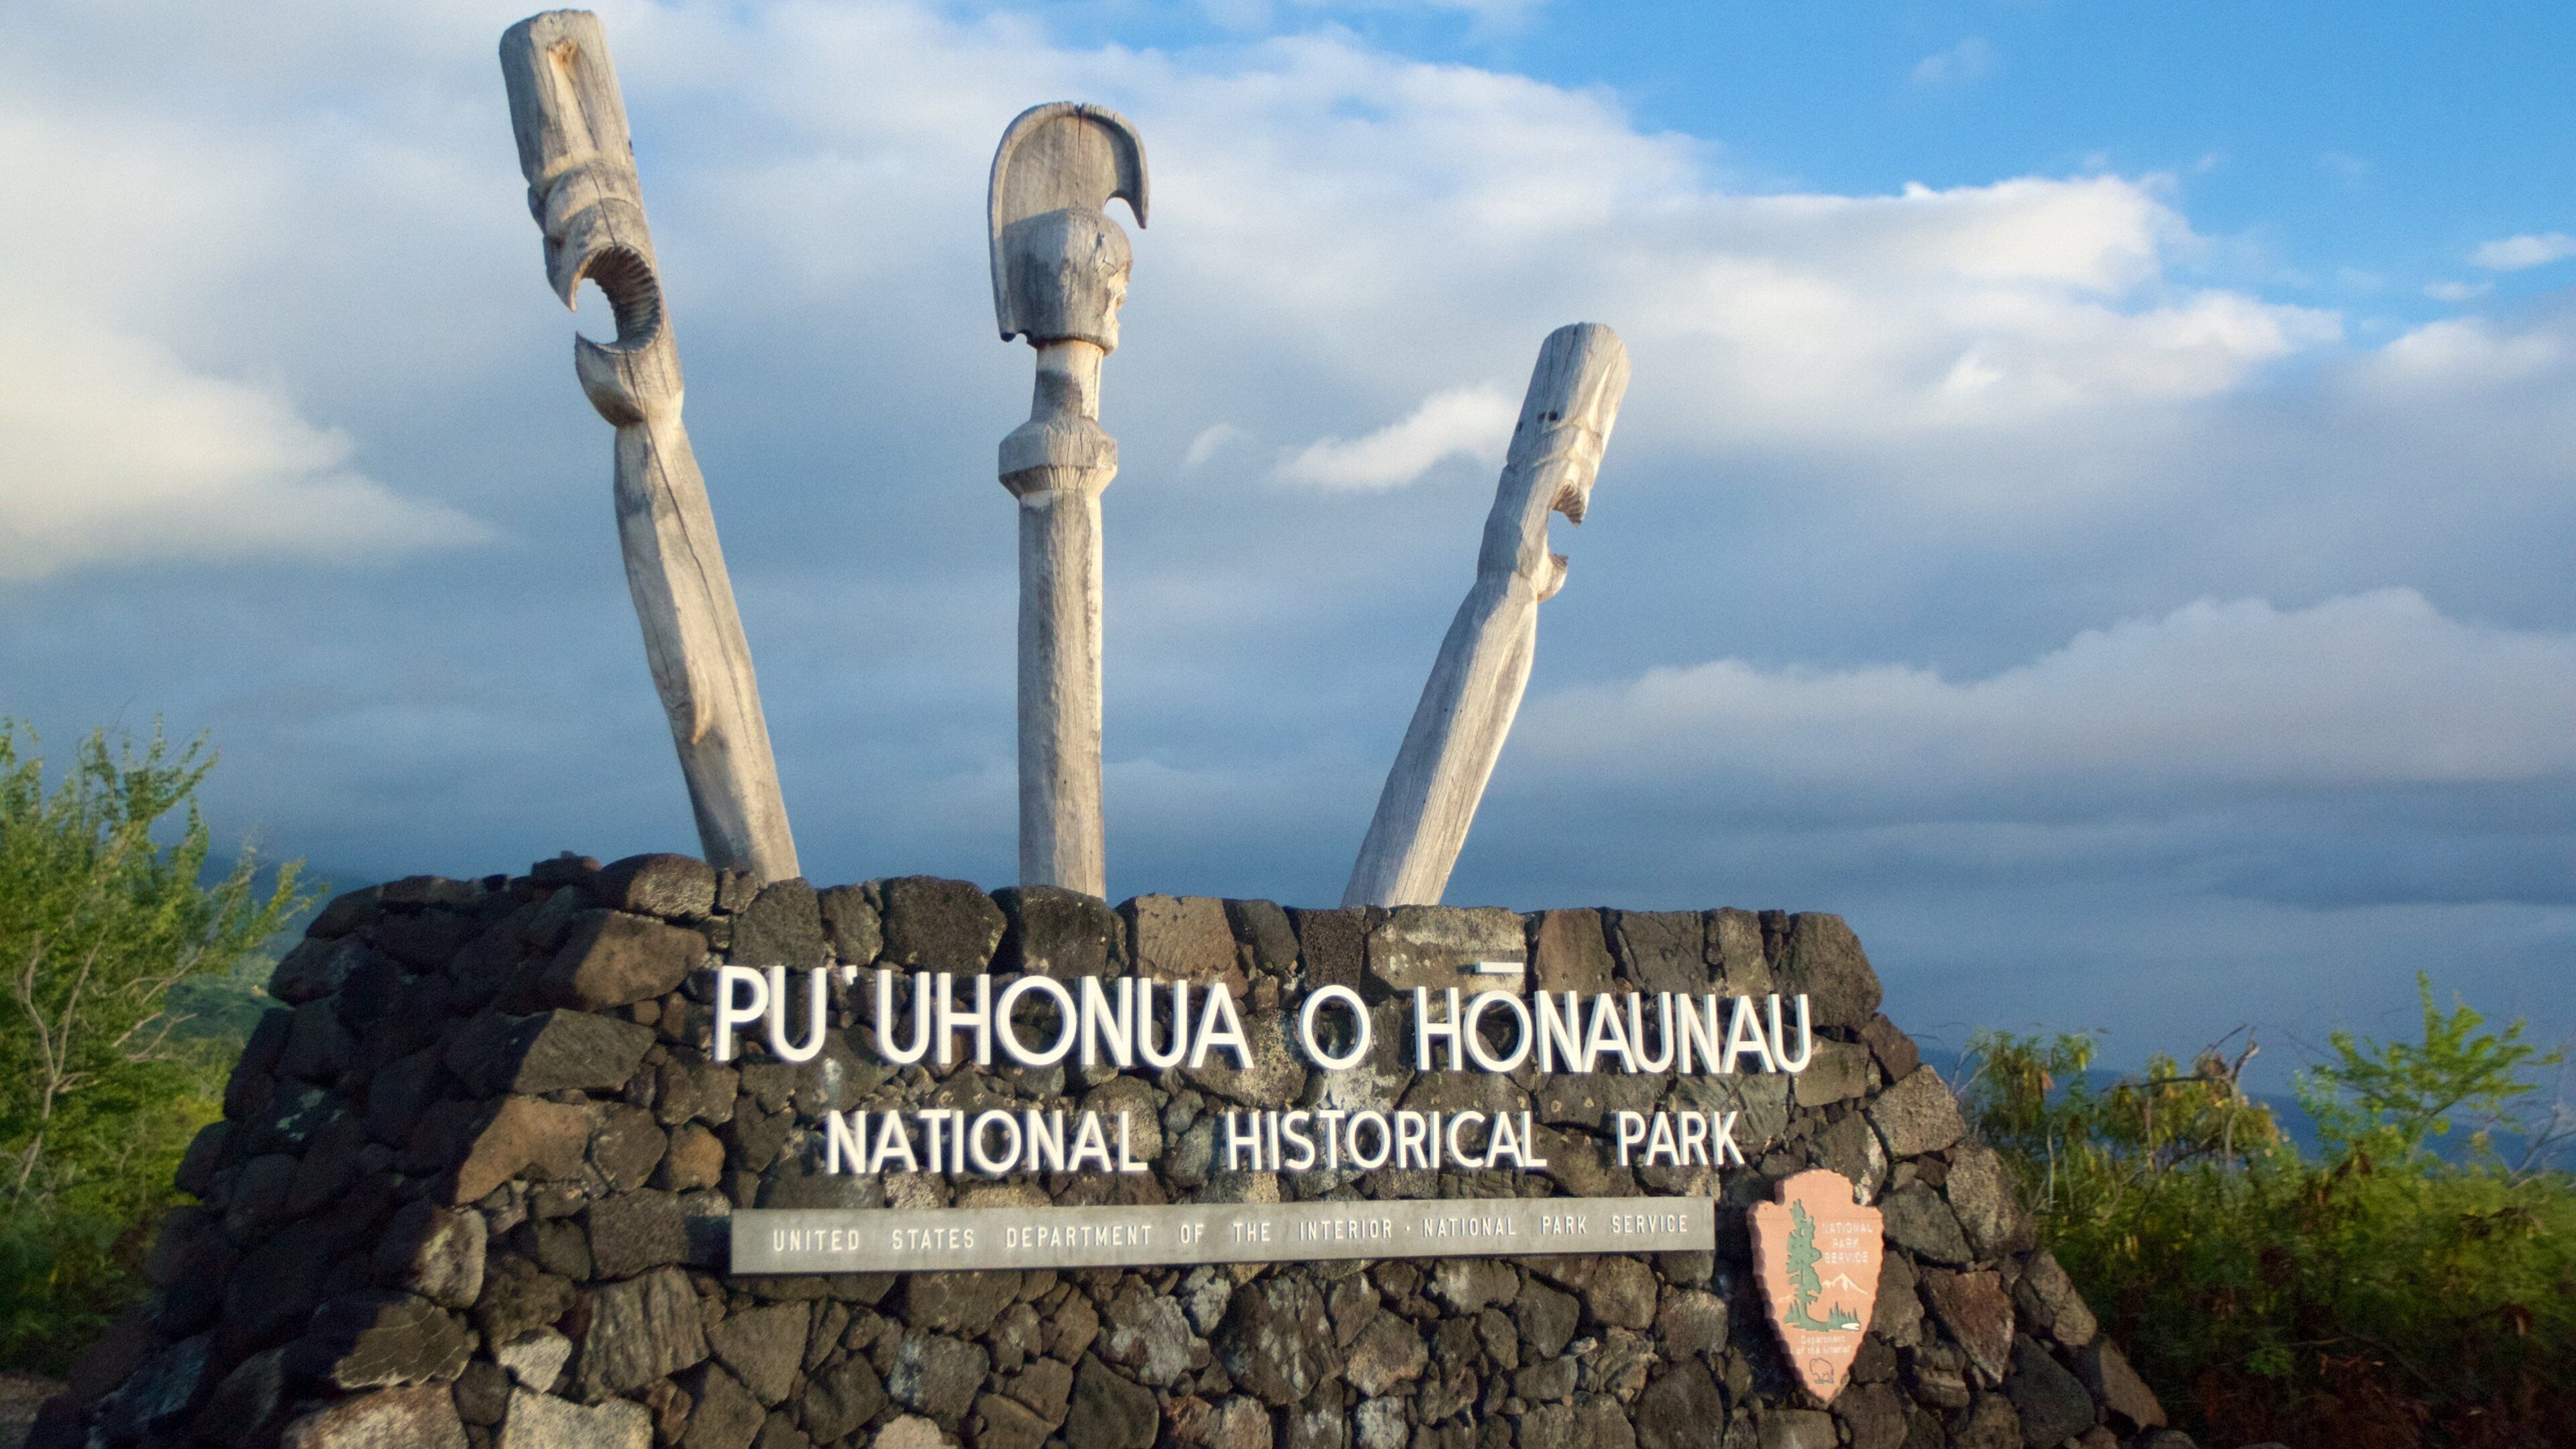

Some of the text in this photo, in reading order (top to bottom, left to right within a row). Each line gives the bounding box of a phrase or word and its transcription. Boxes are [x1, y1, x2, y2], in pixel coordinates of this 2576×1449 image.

[1299, 984, 1371, 1070] O
[827, 1109, 1745, 1175] NATIONAL HISTORICAL PARK
[772, 1229, 860, 1252] UNITED
[892, 1228, 975, 1250] STATES
[1006, 1224, 1152, 1248] DEPARTMENT
[1179, 1223, 1204, 1244] OF
[1232, 1222, 1271, 1242] THE
[1298, 1219, 1392, 1240] INTERIOR
[1422, 1217, 1517, 1238] NATIONAL
[1541, 1216, 1588, 1235] PARK
[1610, 1214, 1688, 1234] SERVICE
[1821, 1222, 1874, 1234] NATIONAL
[1832, 1238, 1859, 1248] PARK
[1824, 1252, 1868, 1264] SERVICE
